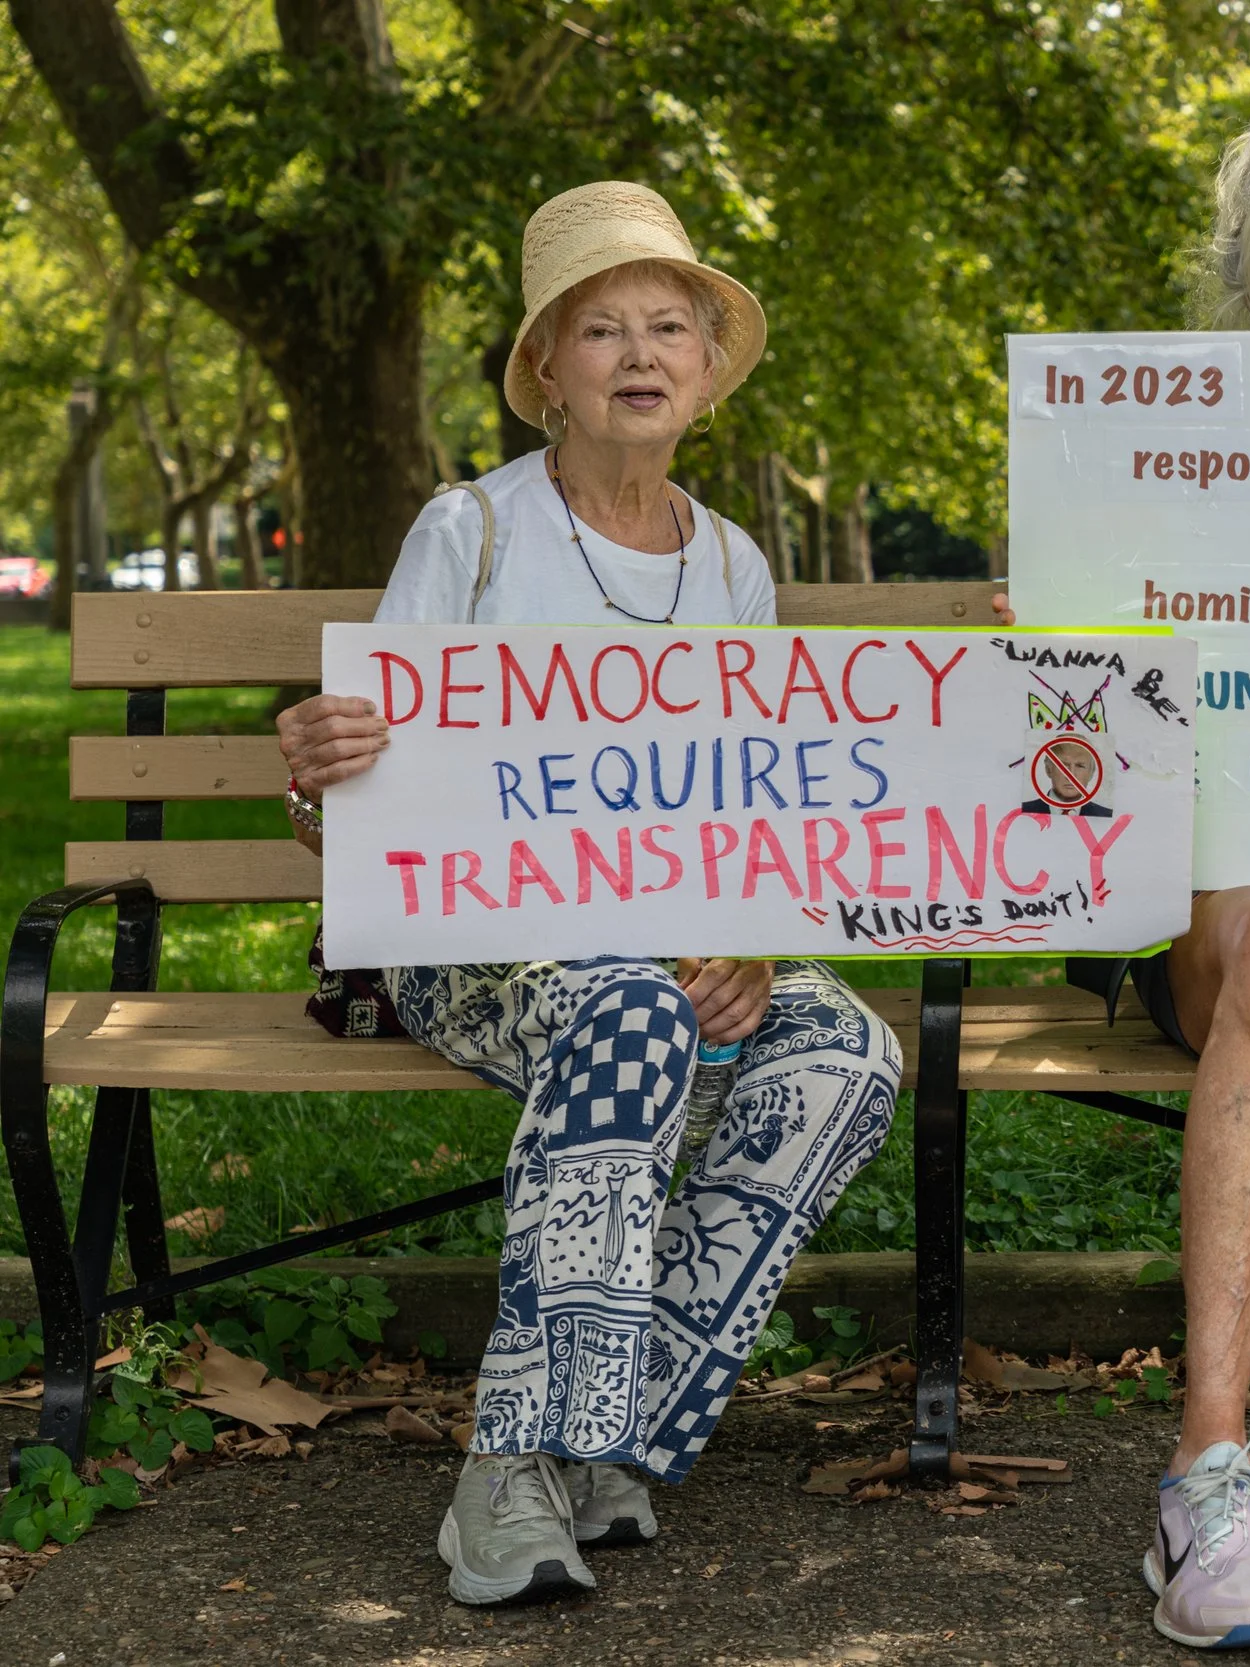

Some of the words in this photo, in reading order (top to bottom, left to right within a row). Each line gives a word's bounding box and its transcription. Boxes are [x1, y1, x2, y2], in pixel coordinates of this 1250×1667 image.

[1045, 364, 1084, 404] In
[1100, 364, 1224, 407] 2023
[368, 635, 968, 729] DEMOCRACY
[491, 736, 889, 821] REQUIRES
[385, 803, 1135, 917] TRANSPARENCY
